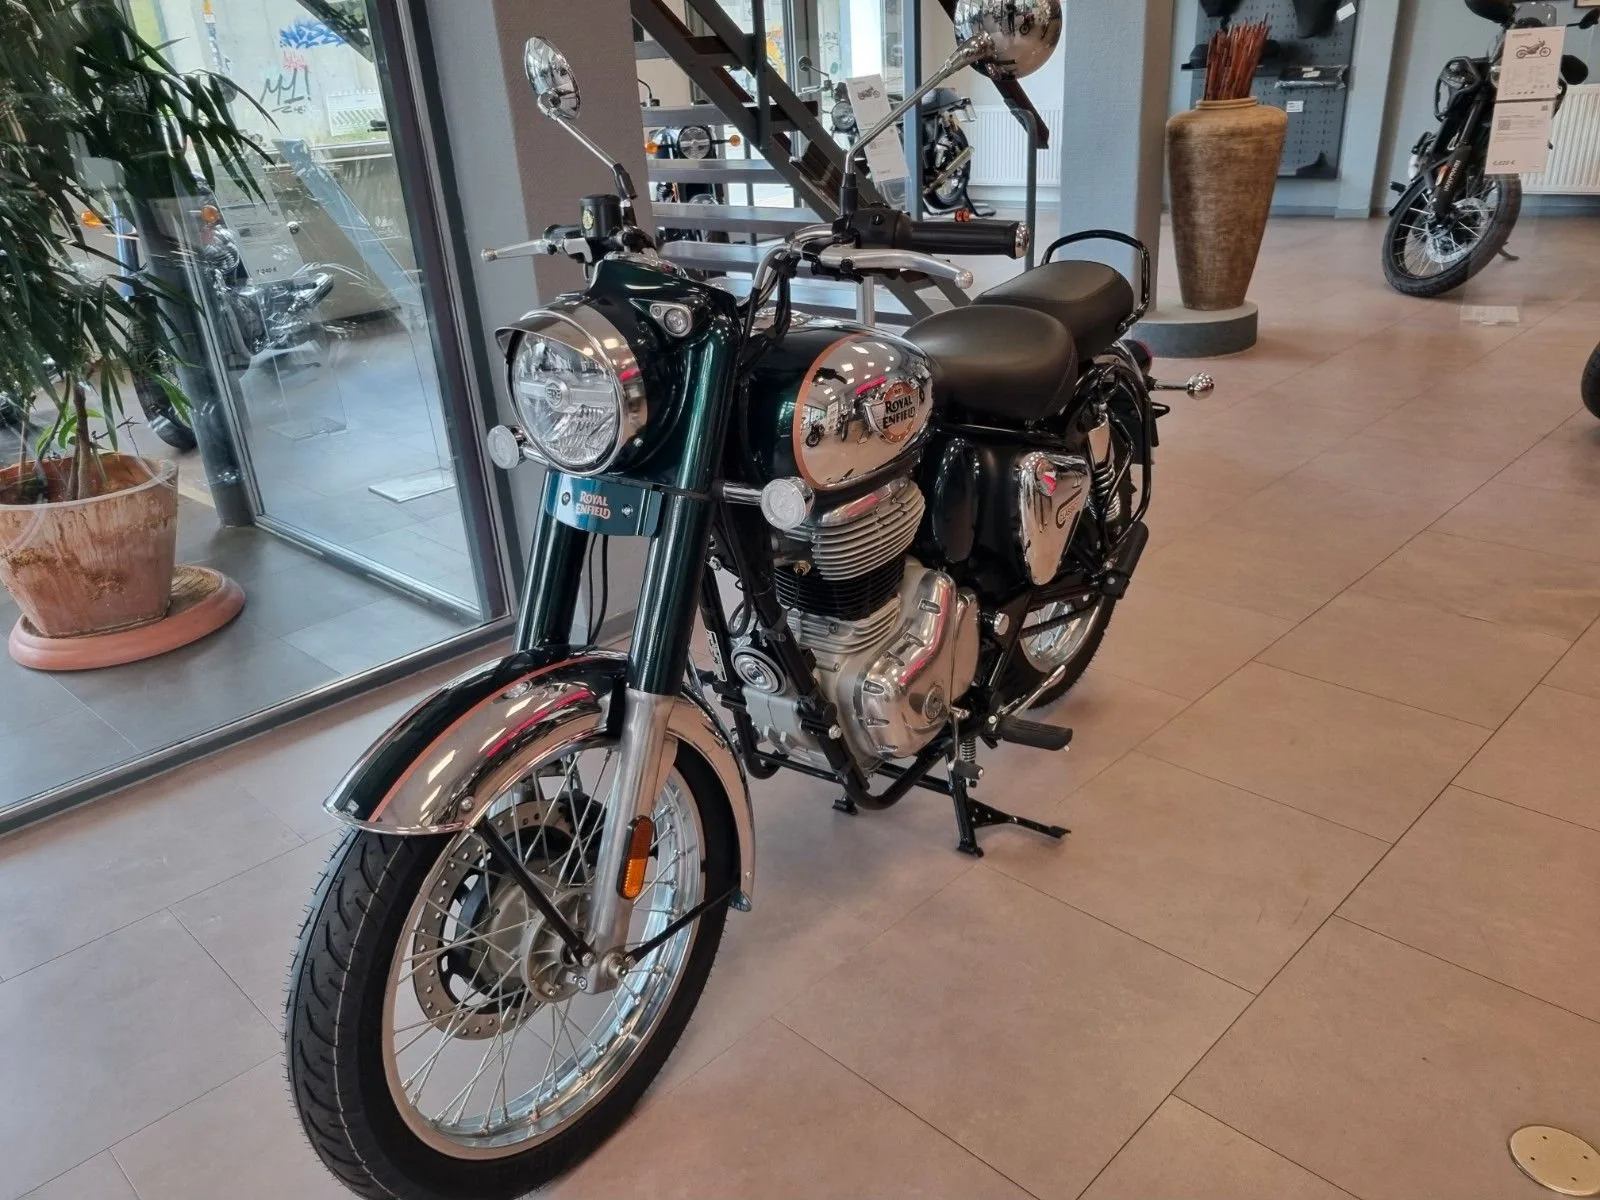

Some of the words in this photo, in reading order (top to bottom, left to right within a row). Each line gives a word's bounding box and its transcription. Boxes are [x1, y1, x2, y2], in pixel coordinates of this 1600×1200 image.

[885, 395, 912, 413] ROYAL
[882, 407, 916, 429] ENFIELD
[580, 490, 608, 506] ROYAL
[576, 503, 611, 520] ENFIELD
